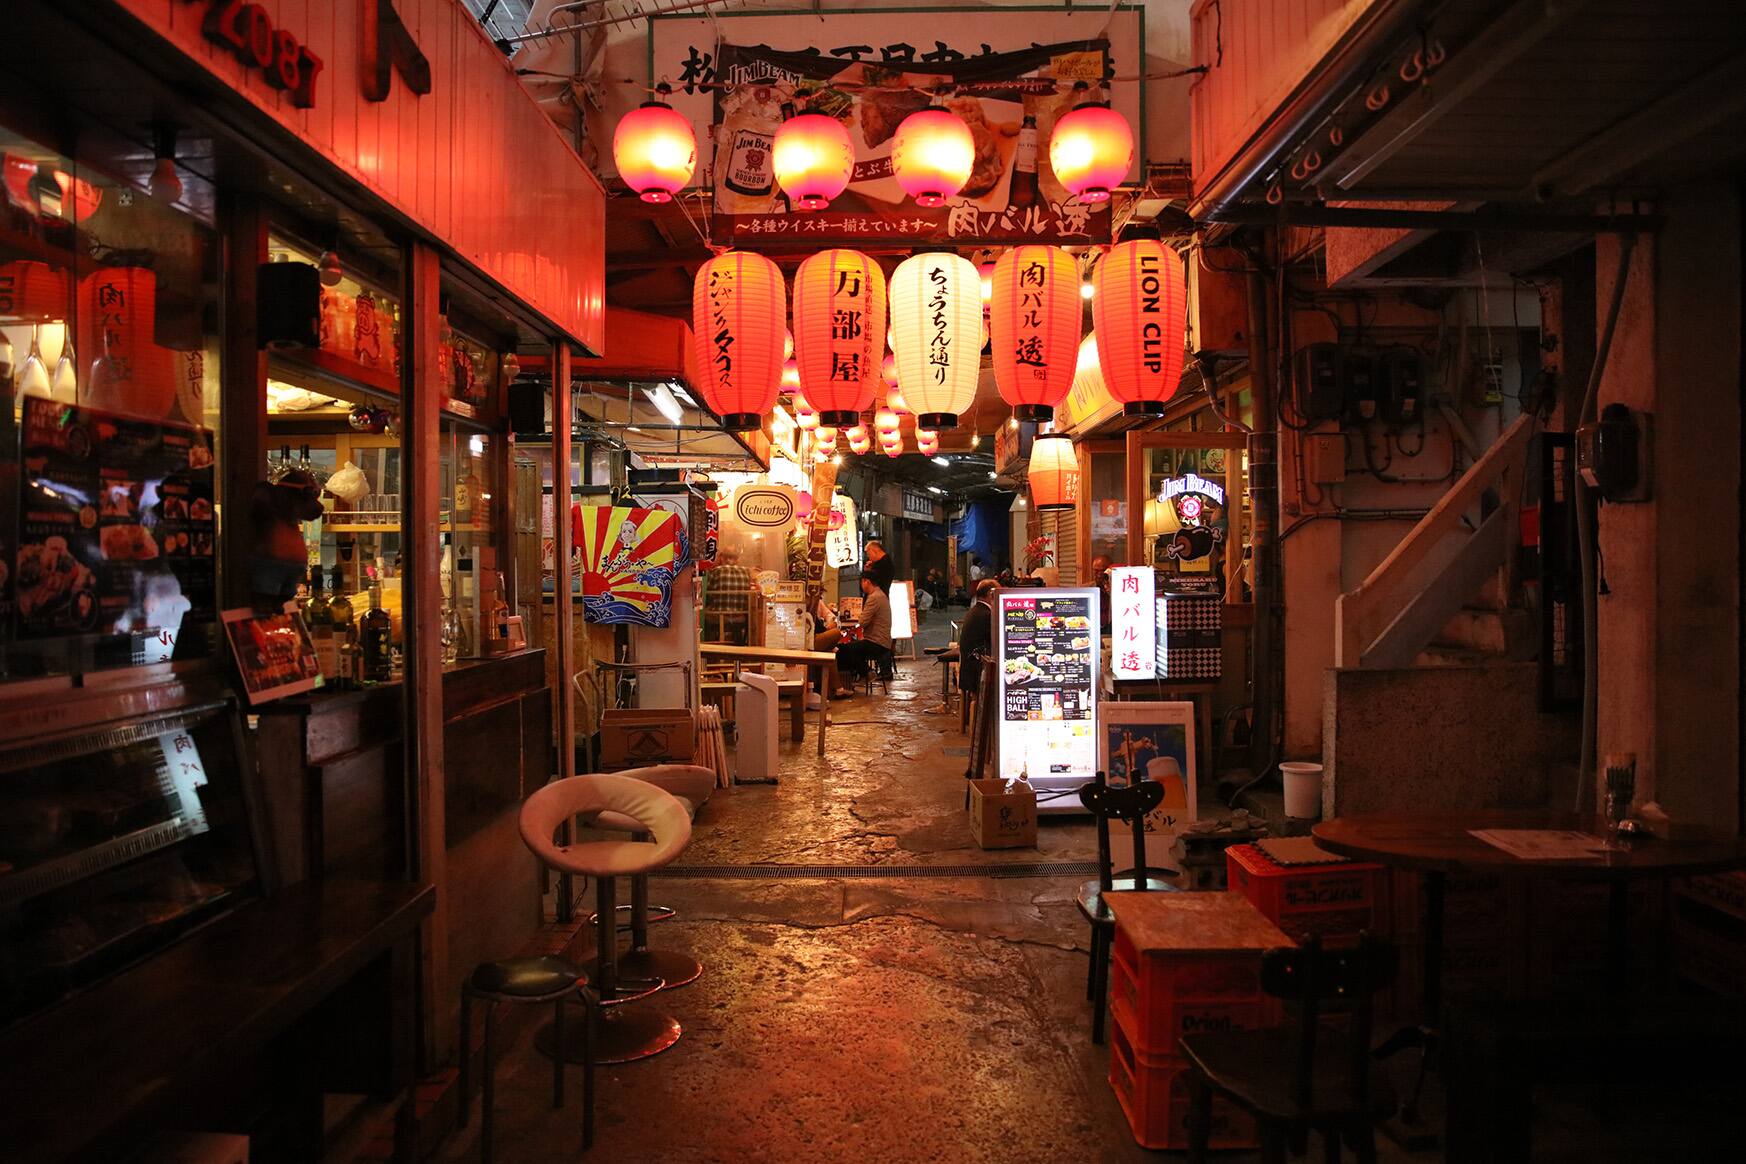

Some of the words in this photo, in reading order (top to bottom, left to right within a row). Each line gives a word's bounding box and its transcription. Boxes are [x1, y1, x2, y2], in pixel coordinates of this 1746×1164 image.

[736, 137, 754, 150] JIM
[754, 139, 772, 152] BEA
[735, 173, 766, 184] BOURBON
[1140, 256, 1160, 313] LION
[829, 270, 862, 382] 万部屋
[928, 267, 951, 386] ちょうちん通り
[1143, 323, 1161, 373] CLIP
[1185, 473, 1224, 504] BEAM
[745, 504, 763, 516] ichi
[763, 504, 787, 516] coffee
[1007, 696, 1028, 704] HIGH
[1007, 704, 1028, 712] BALL
